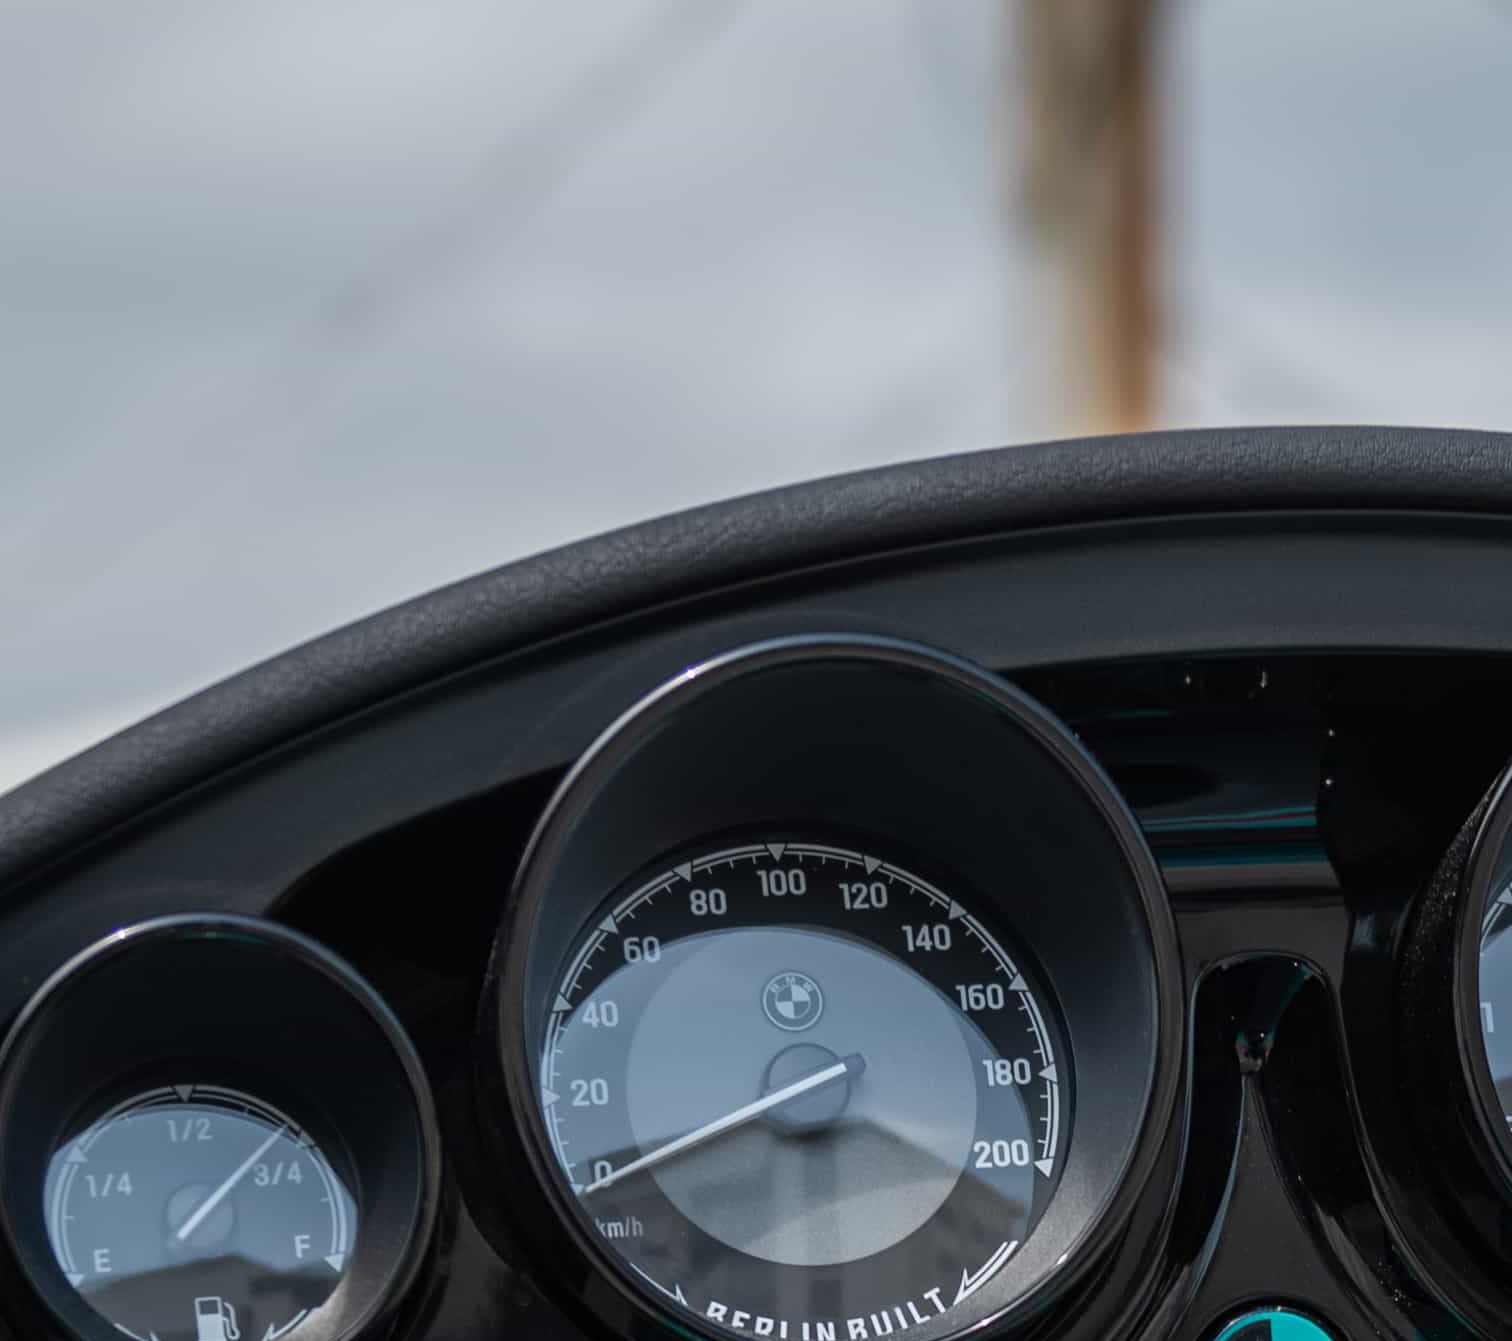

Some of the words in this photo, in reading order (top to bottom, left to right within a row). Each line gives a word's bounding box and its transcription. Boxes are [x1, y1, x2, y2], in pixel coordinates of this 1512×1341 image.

[756, 868, 807, 897] 100
[839, 881, 888, 911] 120
[689, 888, 727, 917] 80
[623, 936, 662, 964] 60
[902, 923, 951, 953] 140
[956, 983, 1005, 1011] 160
[582, 1001, 620, 1028] 40
[1480, 1001, 1495, 1033] 1
[982, 1058, 1032, 1087] 180
[571, 1079, 609, 1107] 20
[167, 1118, 213, 1143] 1/2
[974, 1140, 1031, 1169] 200
[85, 1173, 134, 1199] 1/4
[254, 1160, 304, 1187] 3/4
[295, 1235, 312, 1258] F
[94, 1249, 112, 1274] E
[846, 1287, 948, 1341] BUILT
